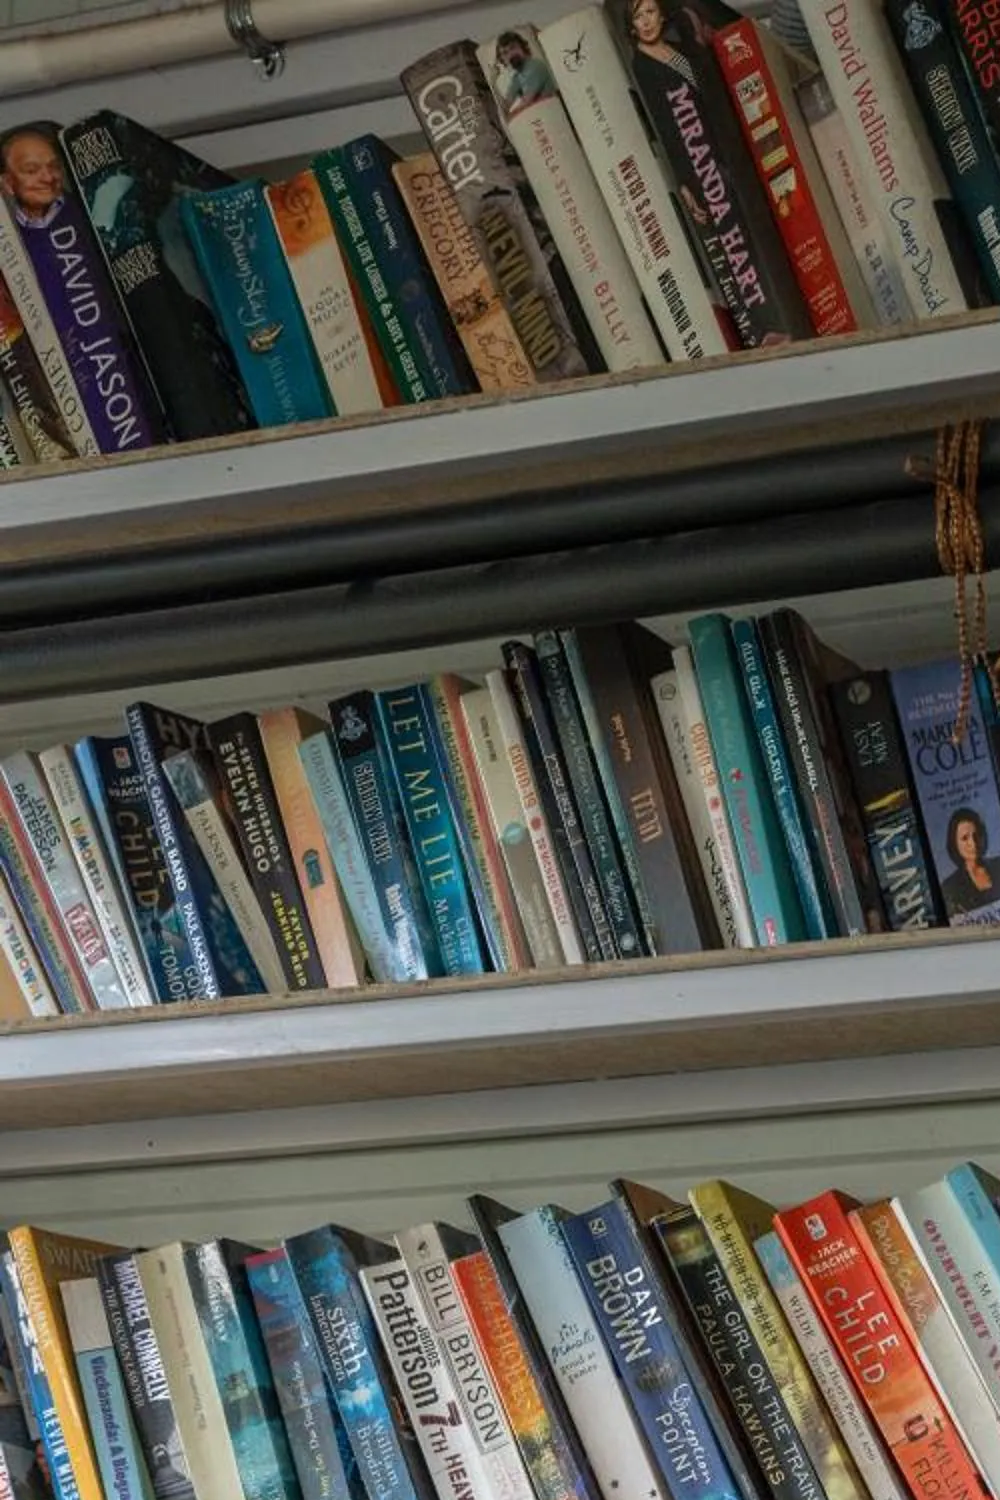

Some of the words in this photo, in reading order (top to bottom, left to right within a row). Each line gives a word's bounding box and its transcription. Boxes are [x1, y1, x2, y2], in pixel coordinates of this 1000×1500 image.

[420, 74, 483, 191] Carter
[825, 5, 865, 80] David
[852, 84, 898, 192] Walliams
[409, 172, 467, 284] GREGORY
[666, 83, 726, 223] MIRANDA
[720, 225, 765, 307] HART
[51, 225, 100, 327] DAVID
[81, 333, 140, 448] JASON
[593, 279, 630, 346] BILLY
[39, 345, 83, 432] COMEY
[389, 697, 427, 754] LET
[916, 740, 987, 776] COLE
[15, 784, 54, 872] PATTERSON
[32, 794, 60, 846] JAMES
[219, 742, 249, 818] EVELYN
[243, 818, 271, 874] HUGO
[404, 772, 441, 822] ME
[115, 811, 158, 906] CHILD
[166, 847, 187, 892] BAND
[114, 1259, 147, 1327] MICHAEL
[133, 1325, 171, 1402] CONNELLY
[373, 1271, 438, 1410] Patterson
[586, 1256, 654, 1364] BROWN
[623, 1265, 663, 1327] DAN
[823, 1287, 888, 1385] CHILD
[855, 1288, 900, 1358] LEE
[423, 1265, 457, 1320] BILL
[448, 1335, 502, 1443] BRYSON
[695, 1304, 734, 1379] PAULA
[730, 1385, 784, 1488] HAWKINS
[704, 1268, 730, 1306] THE
[723, 1310, 754, 1360] GIRL
[746, 1362, 770, 1394] ON
[762, 1397, 792, 1441] THE
[355, 1426, 393, 1500] Brodrick
[372, 1422, 402, 1486] William
[654, 1414, 698, 1484] POINT
